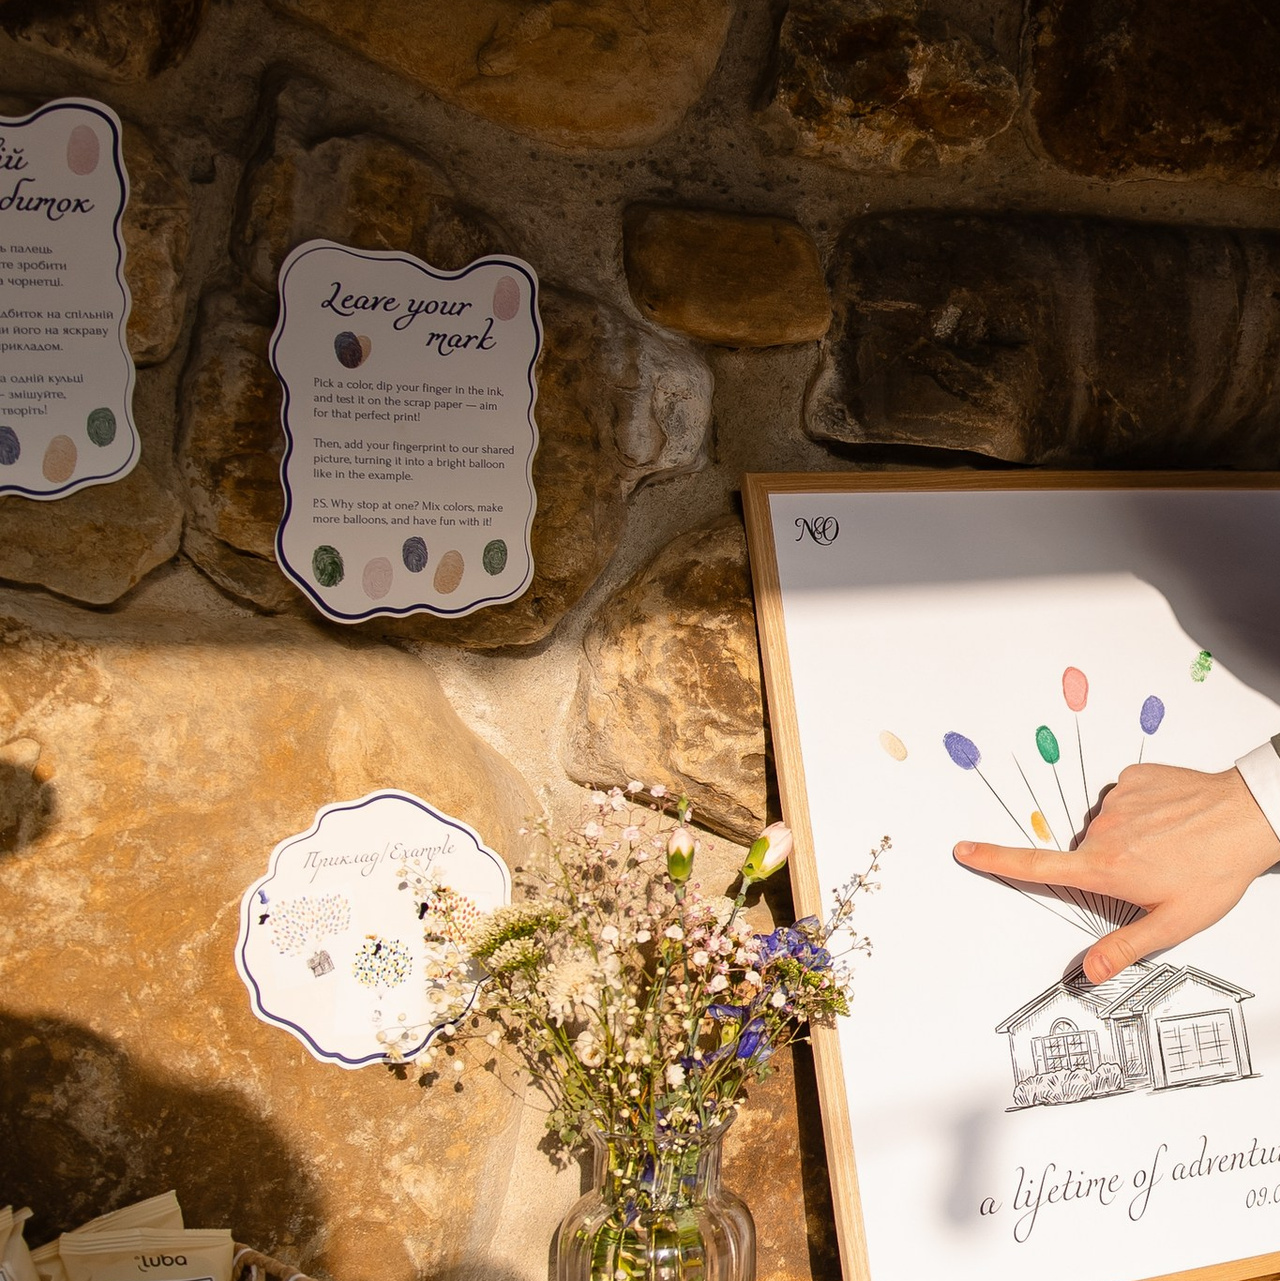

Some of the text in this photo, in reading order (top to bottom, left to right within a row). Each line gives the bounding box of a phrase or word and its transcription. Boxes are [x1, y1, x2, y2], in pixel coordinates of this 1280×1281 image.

[10, 246, 53, 254] палець
[17, 261, 67, 272] зробити
[8, 278, 63, 288] чорнетці.
[321, 282, 472, 331] Leave your
[65, 310, 114, 319] спільній
[13, 326, 41, 335] його
[45, 327, 59, 335] на
[63, 327, 108, 337] яскраву
[425, 318, 497, 356] mark
[0, 342, 63, 353] рикладом.
[10, 374, 44, 383] одній
[48, 374, 84, 385] кульці
[314, 377, 334, 388] Pick
[346, 380, 373, 391] color,
[376, 381, 393, 392] dip
[396, 384, 419, 393] your
[423, 383, 452, 396] finger
[455, 386, 465, 394] in
[468, 386, 484, 395] the
[487, 387, 504, 397] ink,
[314, 394, 333, 403] and
[336, 395, 354, 404] test
[358, 395, 365, 404] it
[385, 396, 401, 406] the
[404, 399, 431, 409] scrap
[434, 401, 462, 410] paper
[480, 401, 497, 410] aim
[1, 404, 48, 417] творіть!
[314, 408, 420, 423] for that perfect print!
[314, 438, 341, 449] Then,
[344, 440, 363, 449] add
[366, 442, 389, 451] your
[393, 441, 446, 453] fingerprint
[449, 444, 459, 452] to
[482, 445, 514, 454] shared
[314, 454, 352, 465] picture,
[355, 455, 391, 467] turning
[395, 457, 401, 465] it
[405, 457, 424, 466] into
[437, 457, 466, 470] bright
[469, 459, 505, 468] balloon
[314, 468, 413, 482] like in the example.
[331, 499, 354, 511] Why
[357, 500, 379, 511] stop
[382, 501, 391, 509] at
[395, 501, 419, 510] one?
[422, 501, 440, 510] Mix
[443, 502, 475, 512] colors,
[477, 503, 504, 512] make
[313, 514, 492, 526] more balloons, and have fun with it!
[980, 1196, 1001, 1216] a
[1013, 1163, 1124, 1243] lifetime
[1128, 1144, 1168, 1221] of
